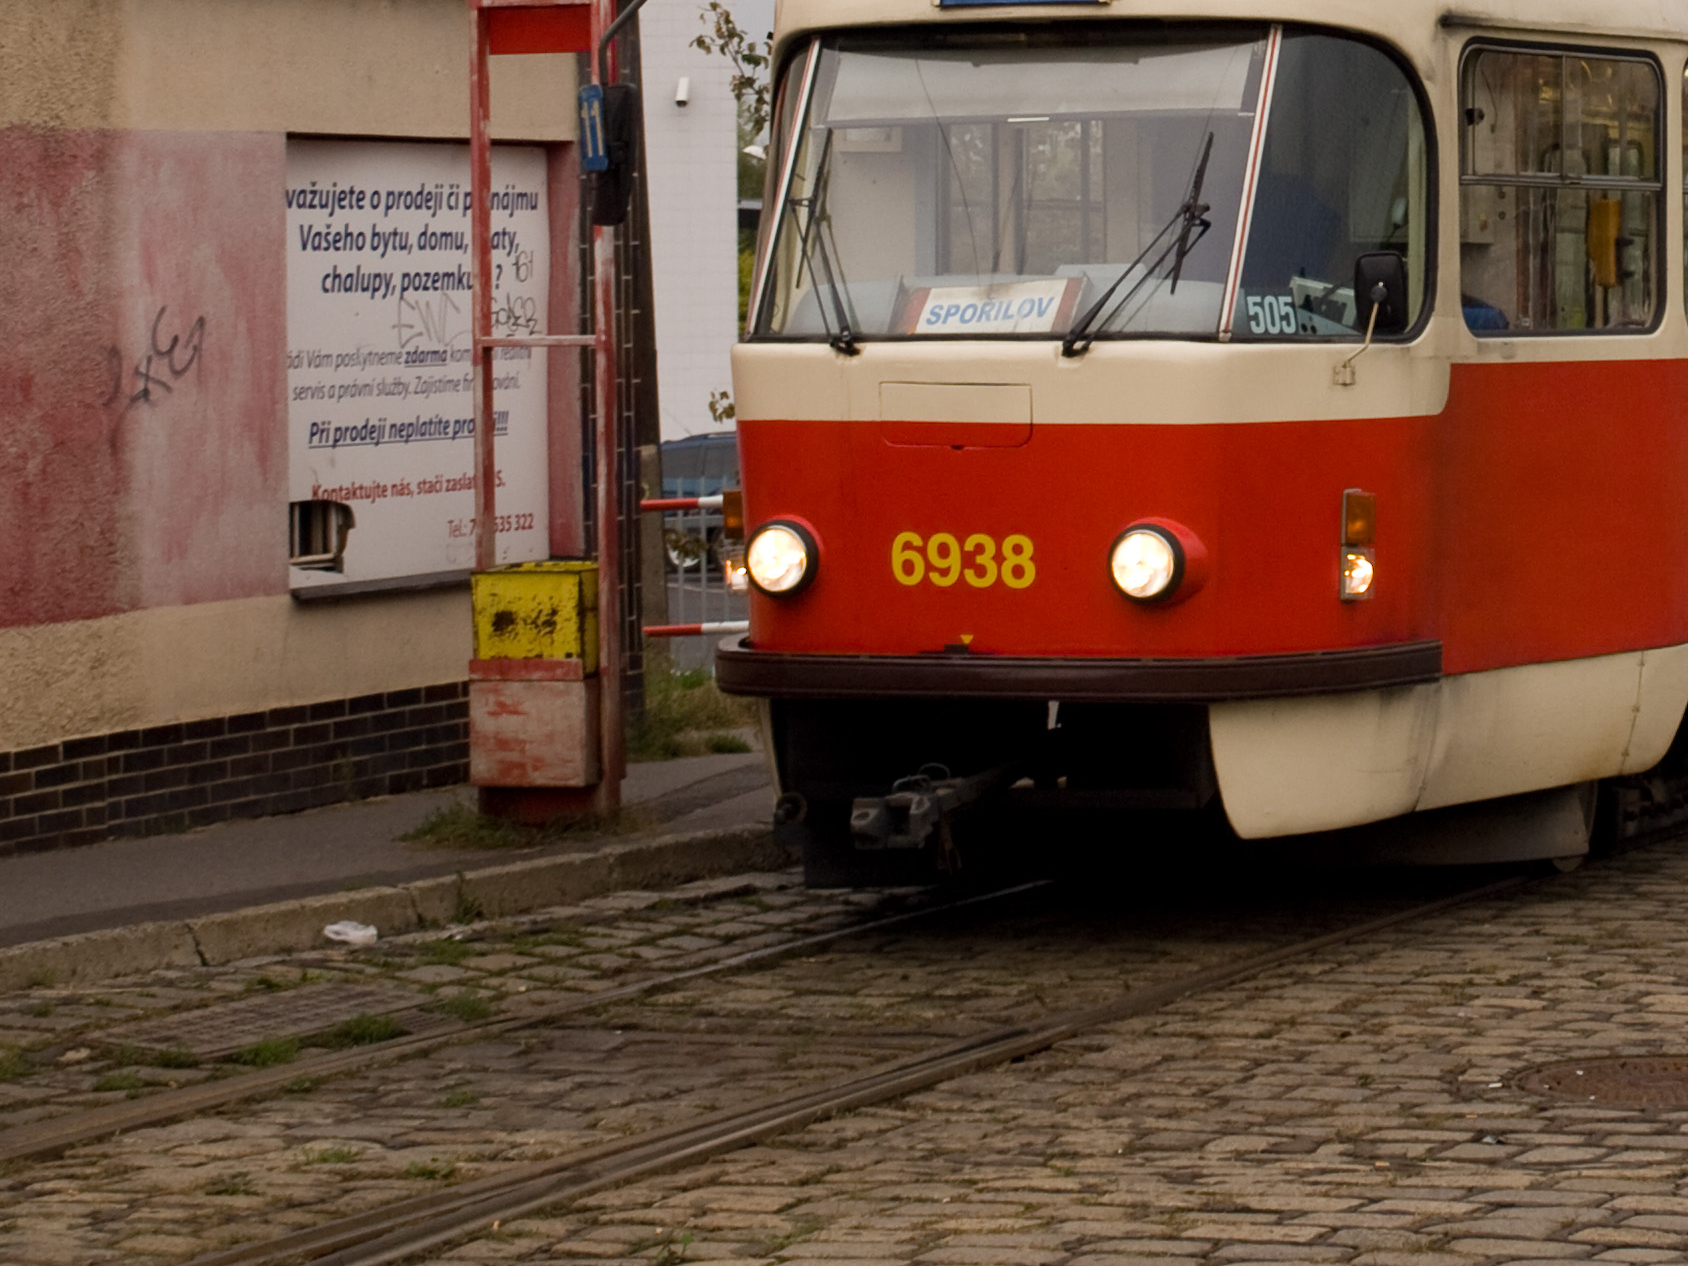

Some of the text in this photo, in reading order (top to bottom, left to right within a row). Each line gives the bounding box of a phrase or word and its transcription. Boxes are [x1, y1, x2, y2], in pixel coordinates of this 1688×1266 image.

[581, 100, 604, 158] 11
[370, 191, 381, 210] o
[384, 183, 442, 218] prodeji
[447, 184, 459, 210] či
[463, 184, 538, 218] pnájmu
[300, 223, 366, 252] Vašeho
[370, 223, 413, 258] bytu,
[418, 223, 468, 255] domu,
[322, 265, 396, 300] chalupy,
[1247, 295, 1297, 334] 505
[306, 349, 333, 368] Vám
[335, 346, 402, 372] poskytneme
[404, 345, 447, 367] zdarma
[293, 382, 325, 401] servis
[327, 383, 336, 399] a
[337, 378, 374, 403] právní
[376, 374, 411, 400] služby.
[414, 375, 460, 399] Zajistíme
[308, 421, 331, 444] Při
[333, 418, 387, 447] prodeji
[389, 413, 449, 444] neplatíte
[312, 481, 388, 504] Kontaktujte
[391, 477, 414, 498] nás,
[417, 475, 444, 494] stačí
[514, 513, 534, 532] 322
[891, 531, 1036, 589] 6938
